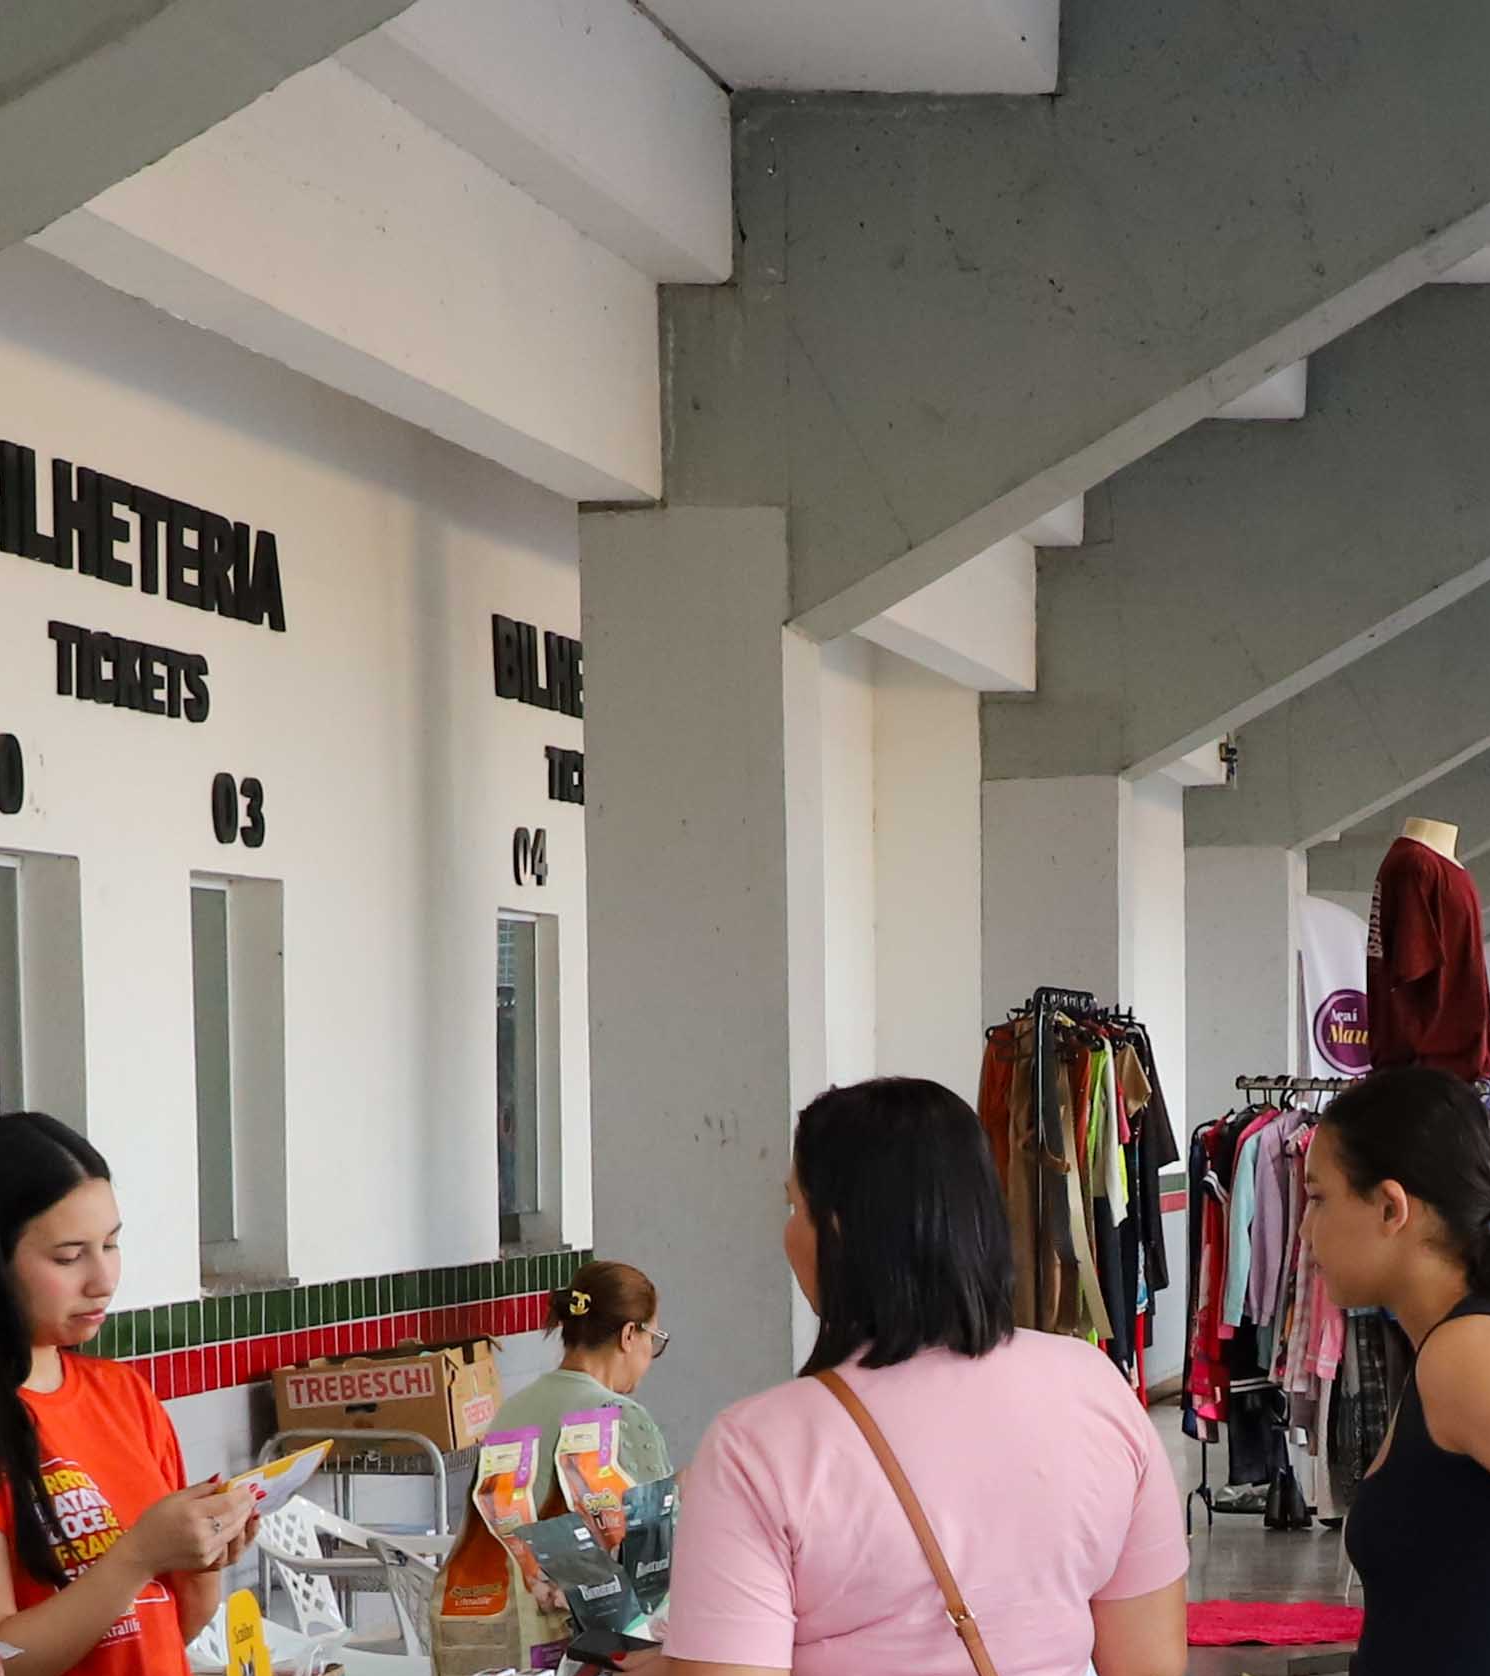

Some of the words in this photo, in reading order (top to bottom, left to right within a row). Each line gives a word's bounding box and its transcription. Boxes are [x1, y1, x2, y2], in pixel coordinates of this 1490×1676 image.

[48, 620, 210, 723] TICKETS
[212, 772, 265, 848] 03
[513, 826, 548, 887] 04
[290, 1369, 432, 1405] TREBESCHI
